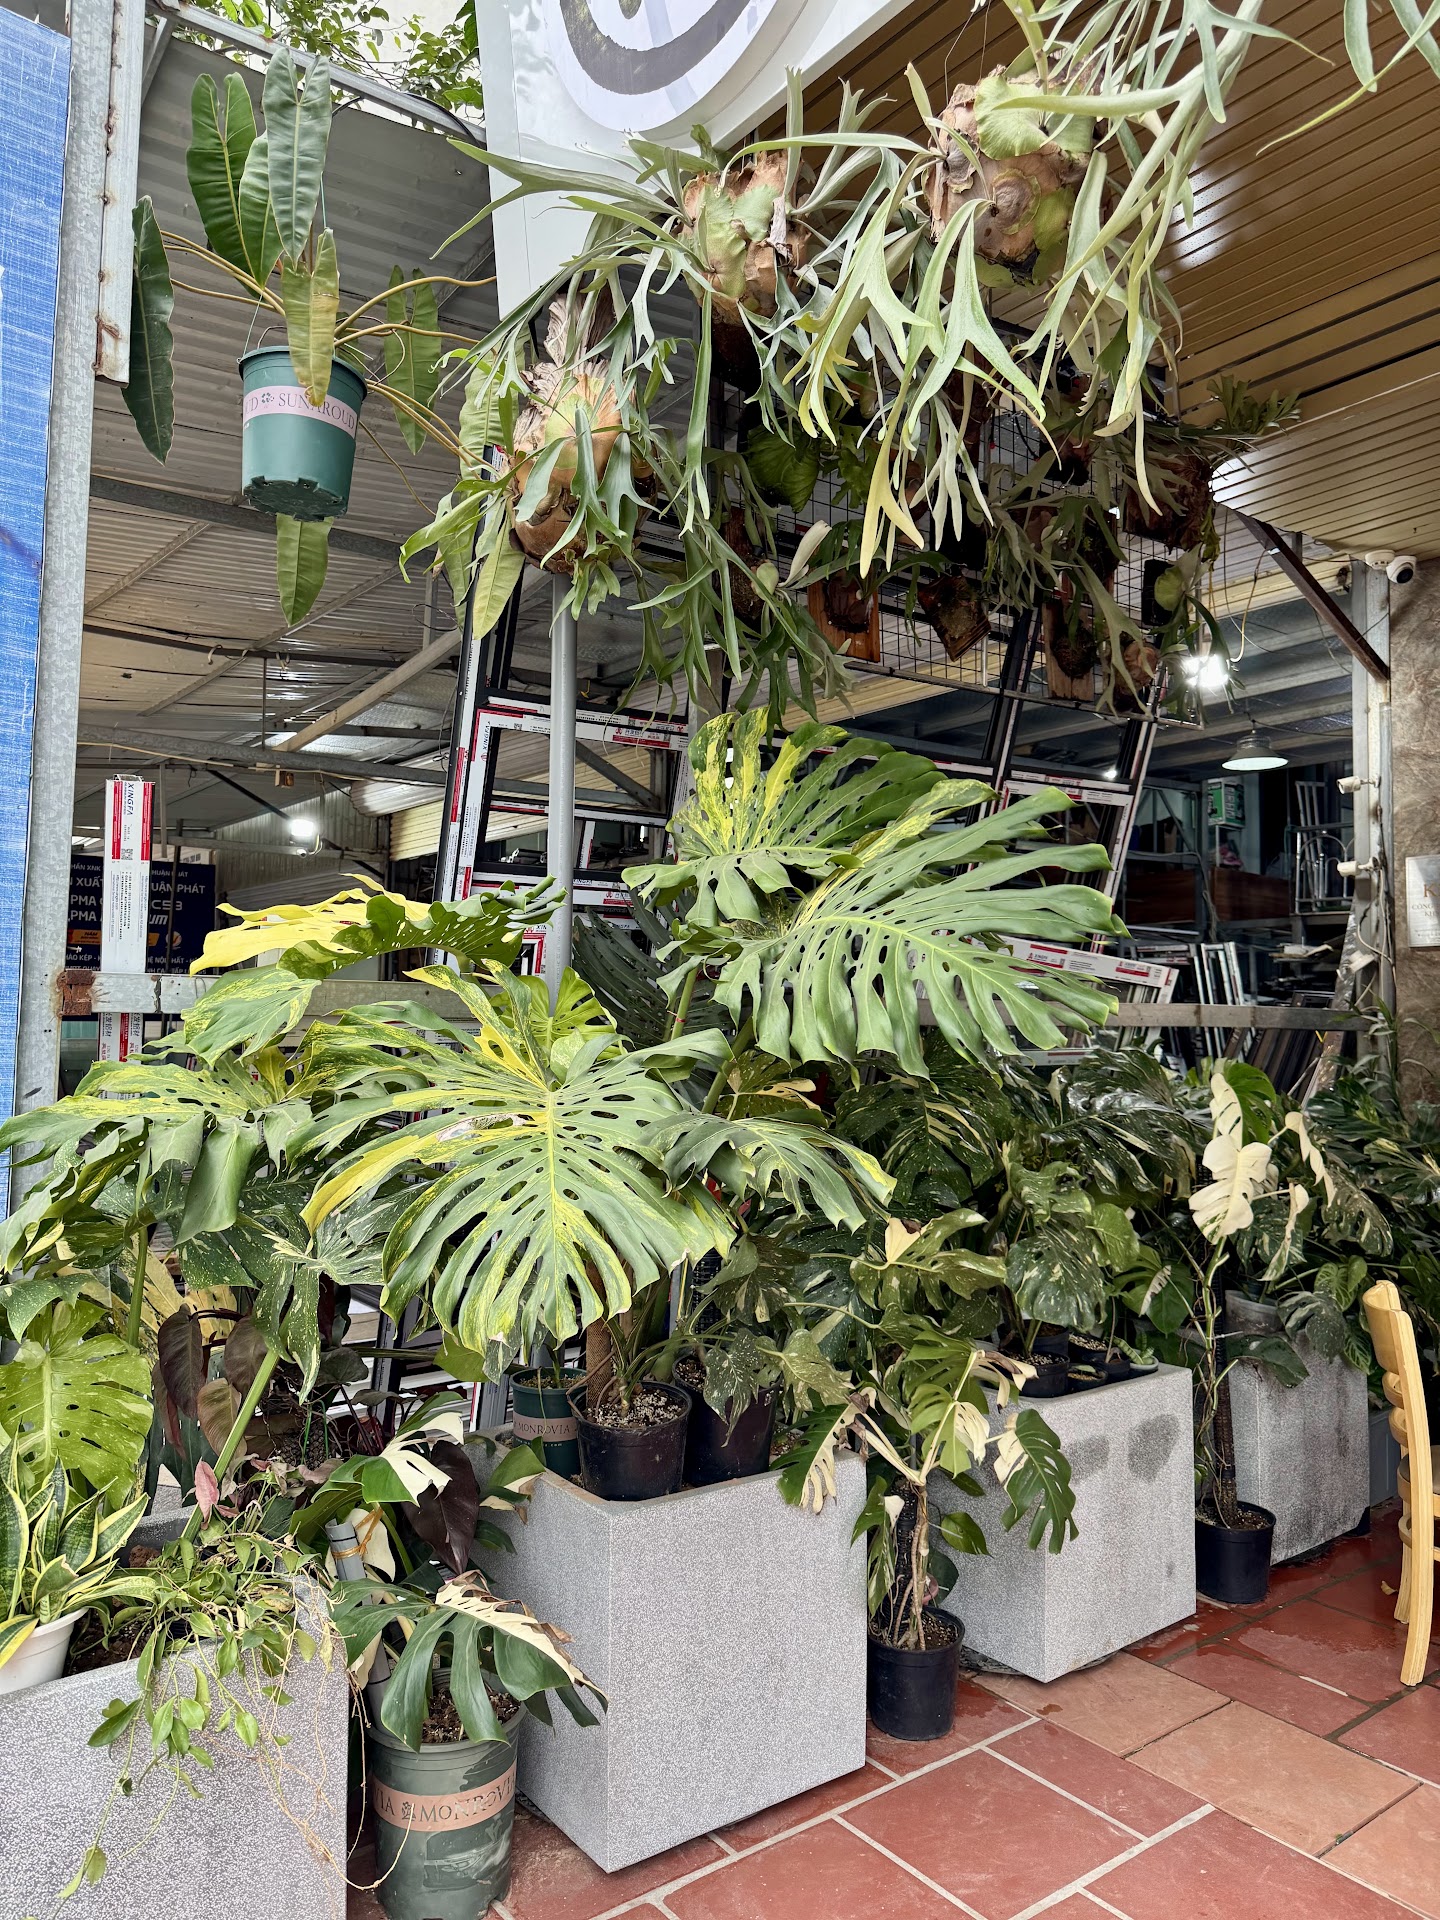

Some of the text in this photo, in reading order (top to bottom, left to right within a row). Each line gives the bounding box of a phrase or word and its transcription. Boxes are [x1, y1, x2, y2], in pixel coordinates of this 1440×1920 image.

[278, 392, 356, 430] SUNROUD
[126, 782, 135, 816] XINGFA
[151, 880, 206, 895] UẬN PHÁT
[518, 1422, 570, 1435] MONROVIA
